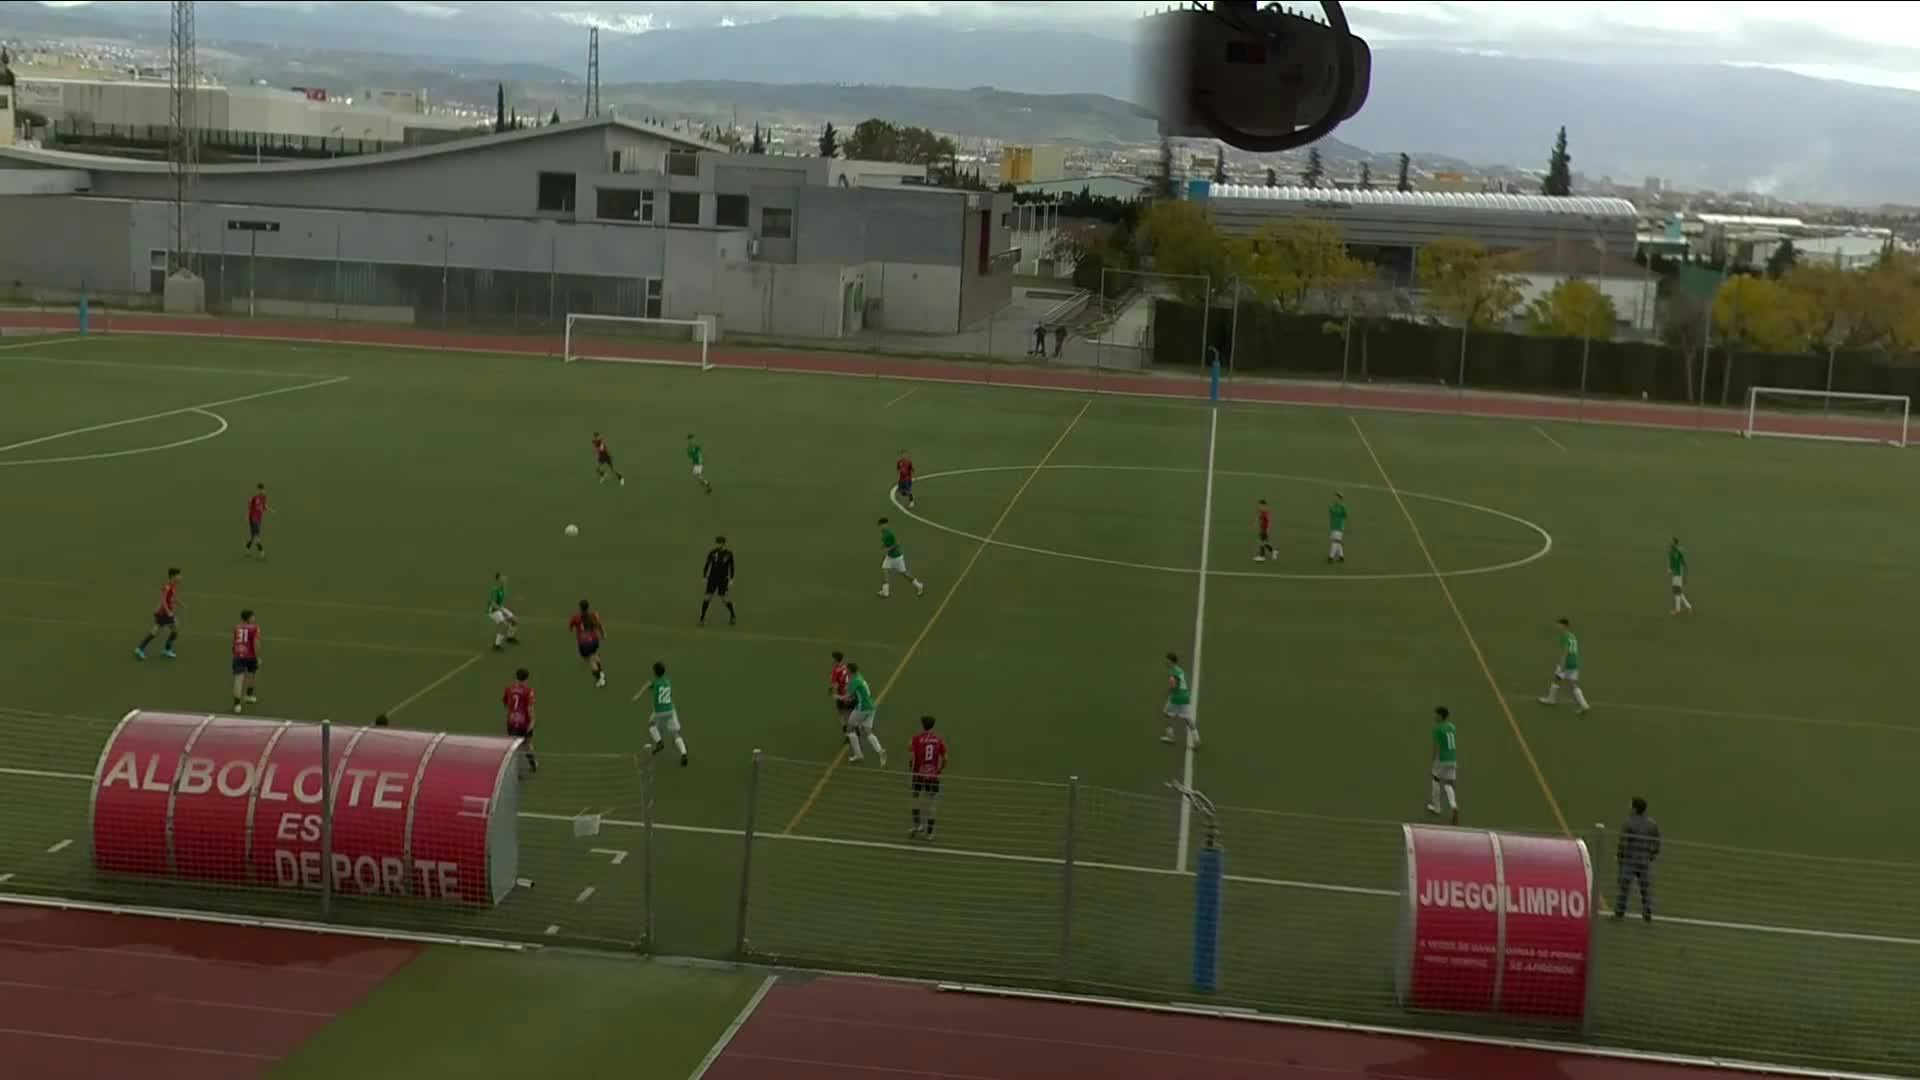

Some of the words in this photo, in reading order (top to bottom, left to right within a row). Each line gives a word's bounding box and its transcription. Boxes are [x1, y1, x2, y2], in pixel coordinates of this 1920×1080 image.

[512, 694, 520, 711] 7
[658, 686, 671, 704] 22
[925, 743, 934, 760] 8
[102, 752, 409, 809] ALBOLOTE
[277, 813, 323, 842] ES
[275, 849, 460, 898] DEPORTE
[1420, 880, 1498, 912] JUEGO
[1504, 884, 1585, 918] LIMPIO
